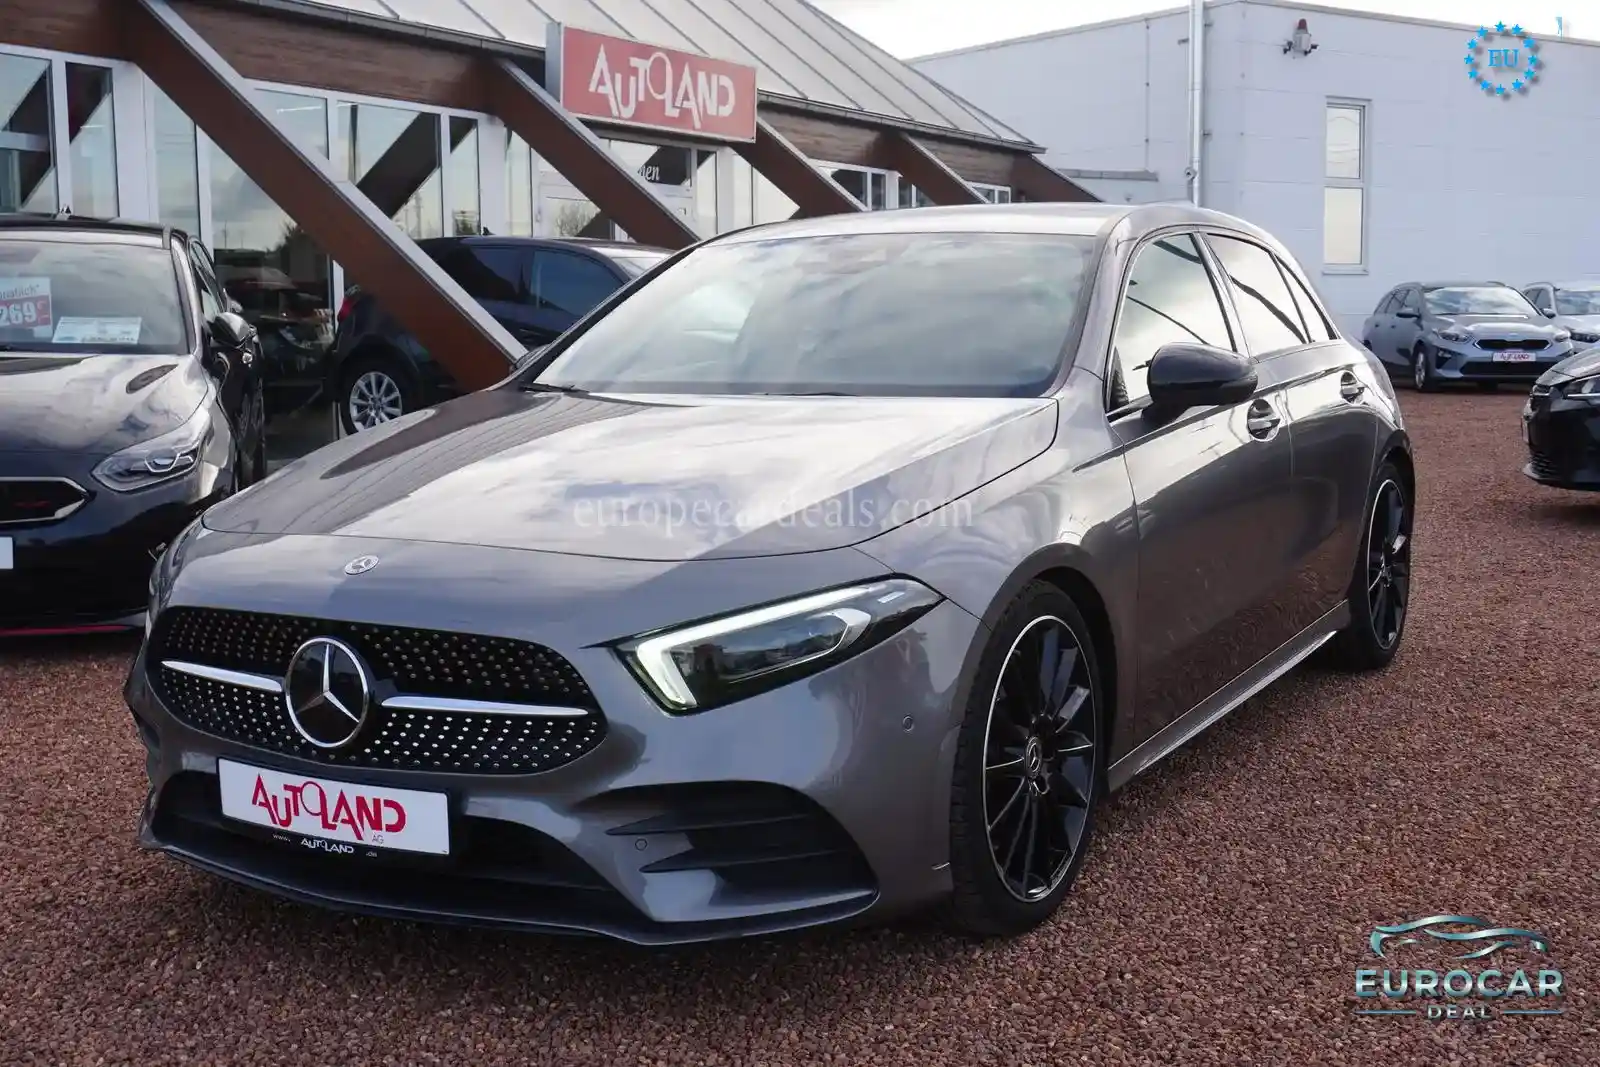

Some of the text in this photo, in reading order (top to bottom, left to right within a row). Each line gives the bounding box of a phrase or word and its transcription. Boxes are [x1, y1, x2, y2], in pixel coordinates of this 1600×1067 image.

[588, 43, 736, 130] AUTOLAND
[251, 773, 406, 841] AUTOLAND
[371, 834, 384, 845] AG
